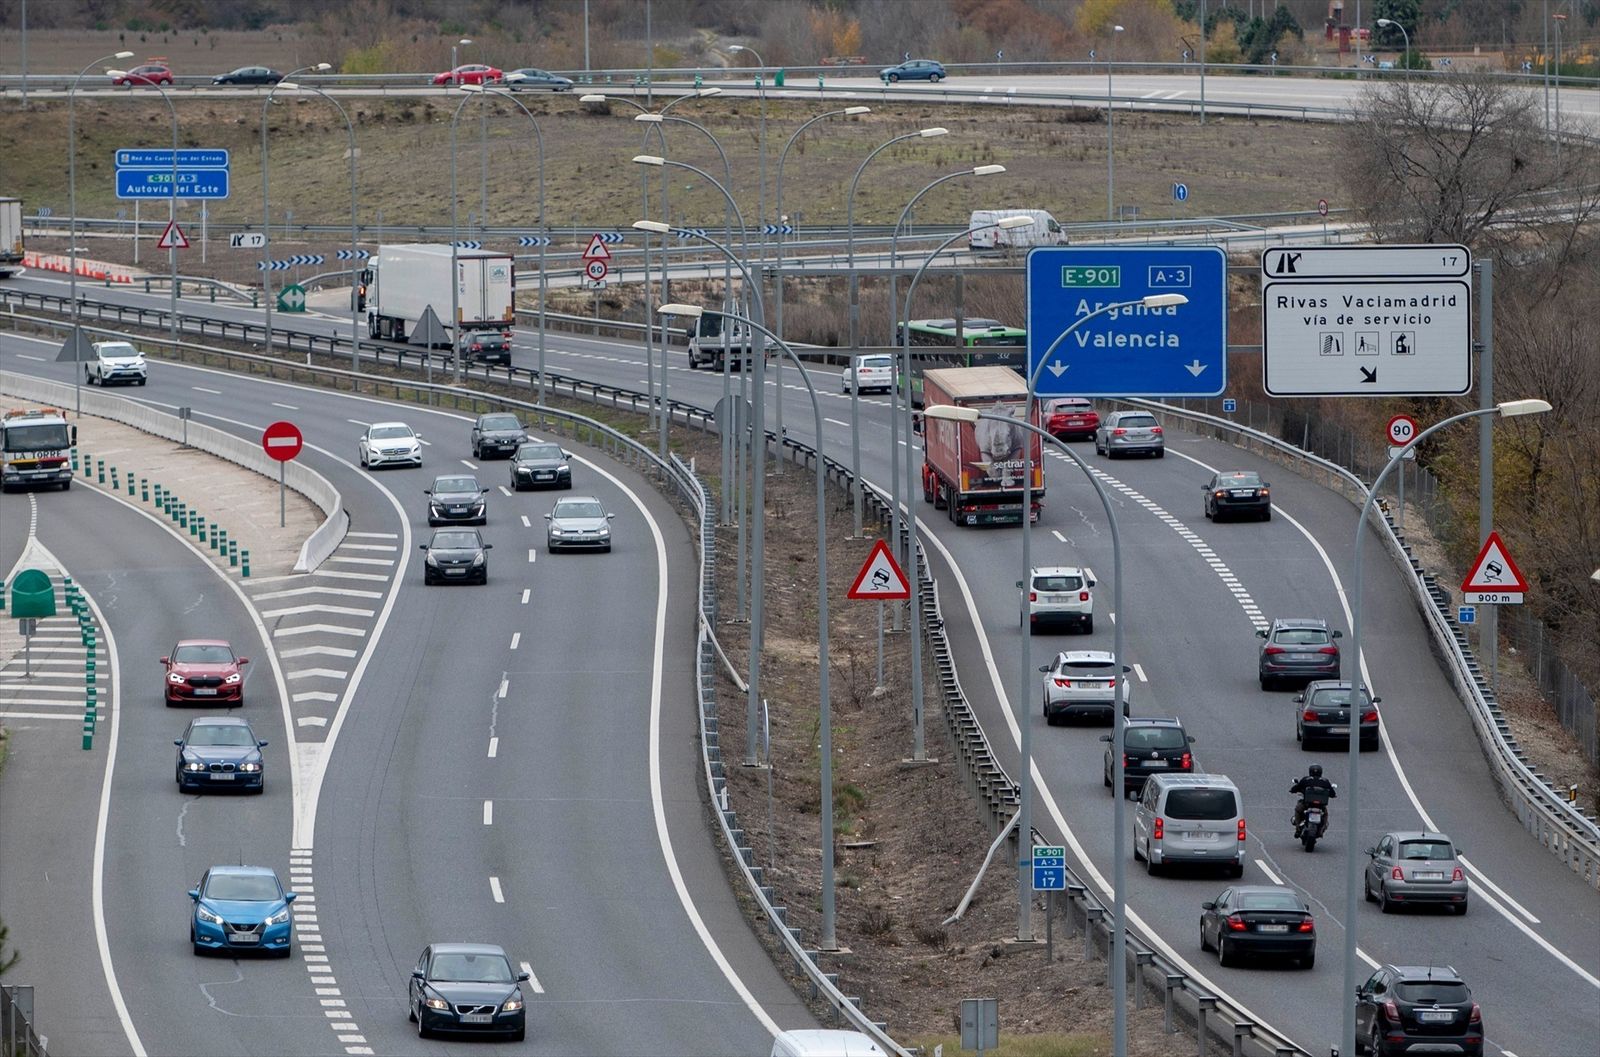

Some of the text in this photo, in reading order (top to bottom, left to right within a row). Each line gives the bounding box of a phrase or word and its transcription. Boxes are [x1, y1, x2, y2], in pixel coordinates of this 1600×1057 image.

[126, 184, 169, 193] Autovía
[194, 185, 219, 193] Este
[251, 236, 261, 245] 17
[1441, 257, 1458, 267] 17
[590, 265, 603, 274] 60
[1065, 269, 1117, 284] E-901
[1155, 270, 1186, 283] A-3
[1277, 294, 1457, 309] Rivas Vaciamadrid
[1303, 313, 1432, 326] vía de servicio
[1074, 330, 1180, 348] Valencia
[1393, 425, 1411, 436] 90
[14, 450, 62, 460] LA TORRE
[1478, 594, 1498, 602] 900
[1042, 877, 1056, 887] 17
